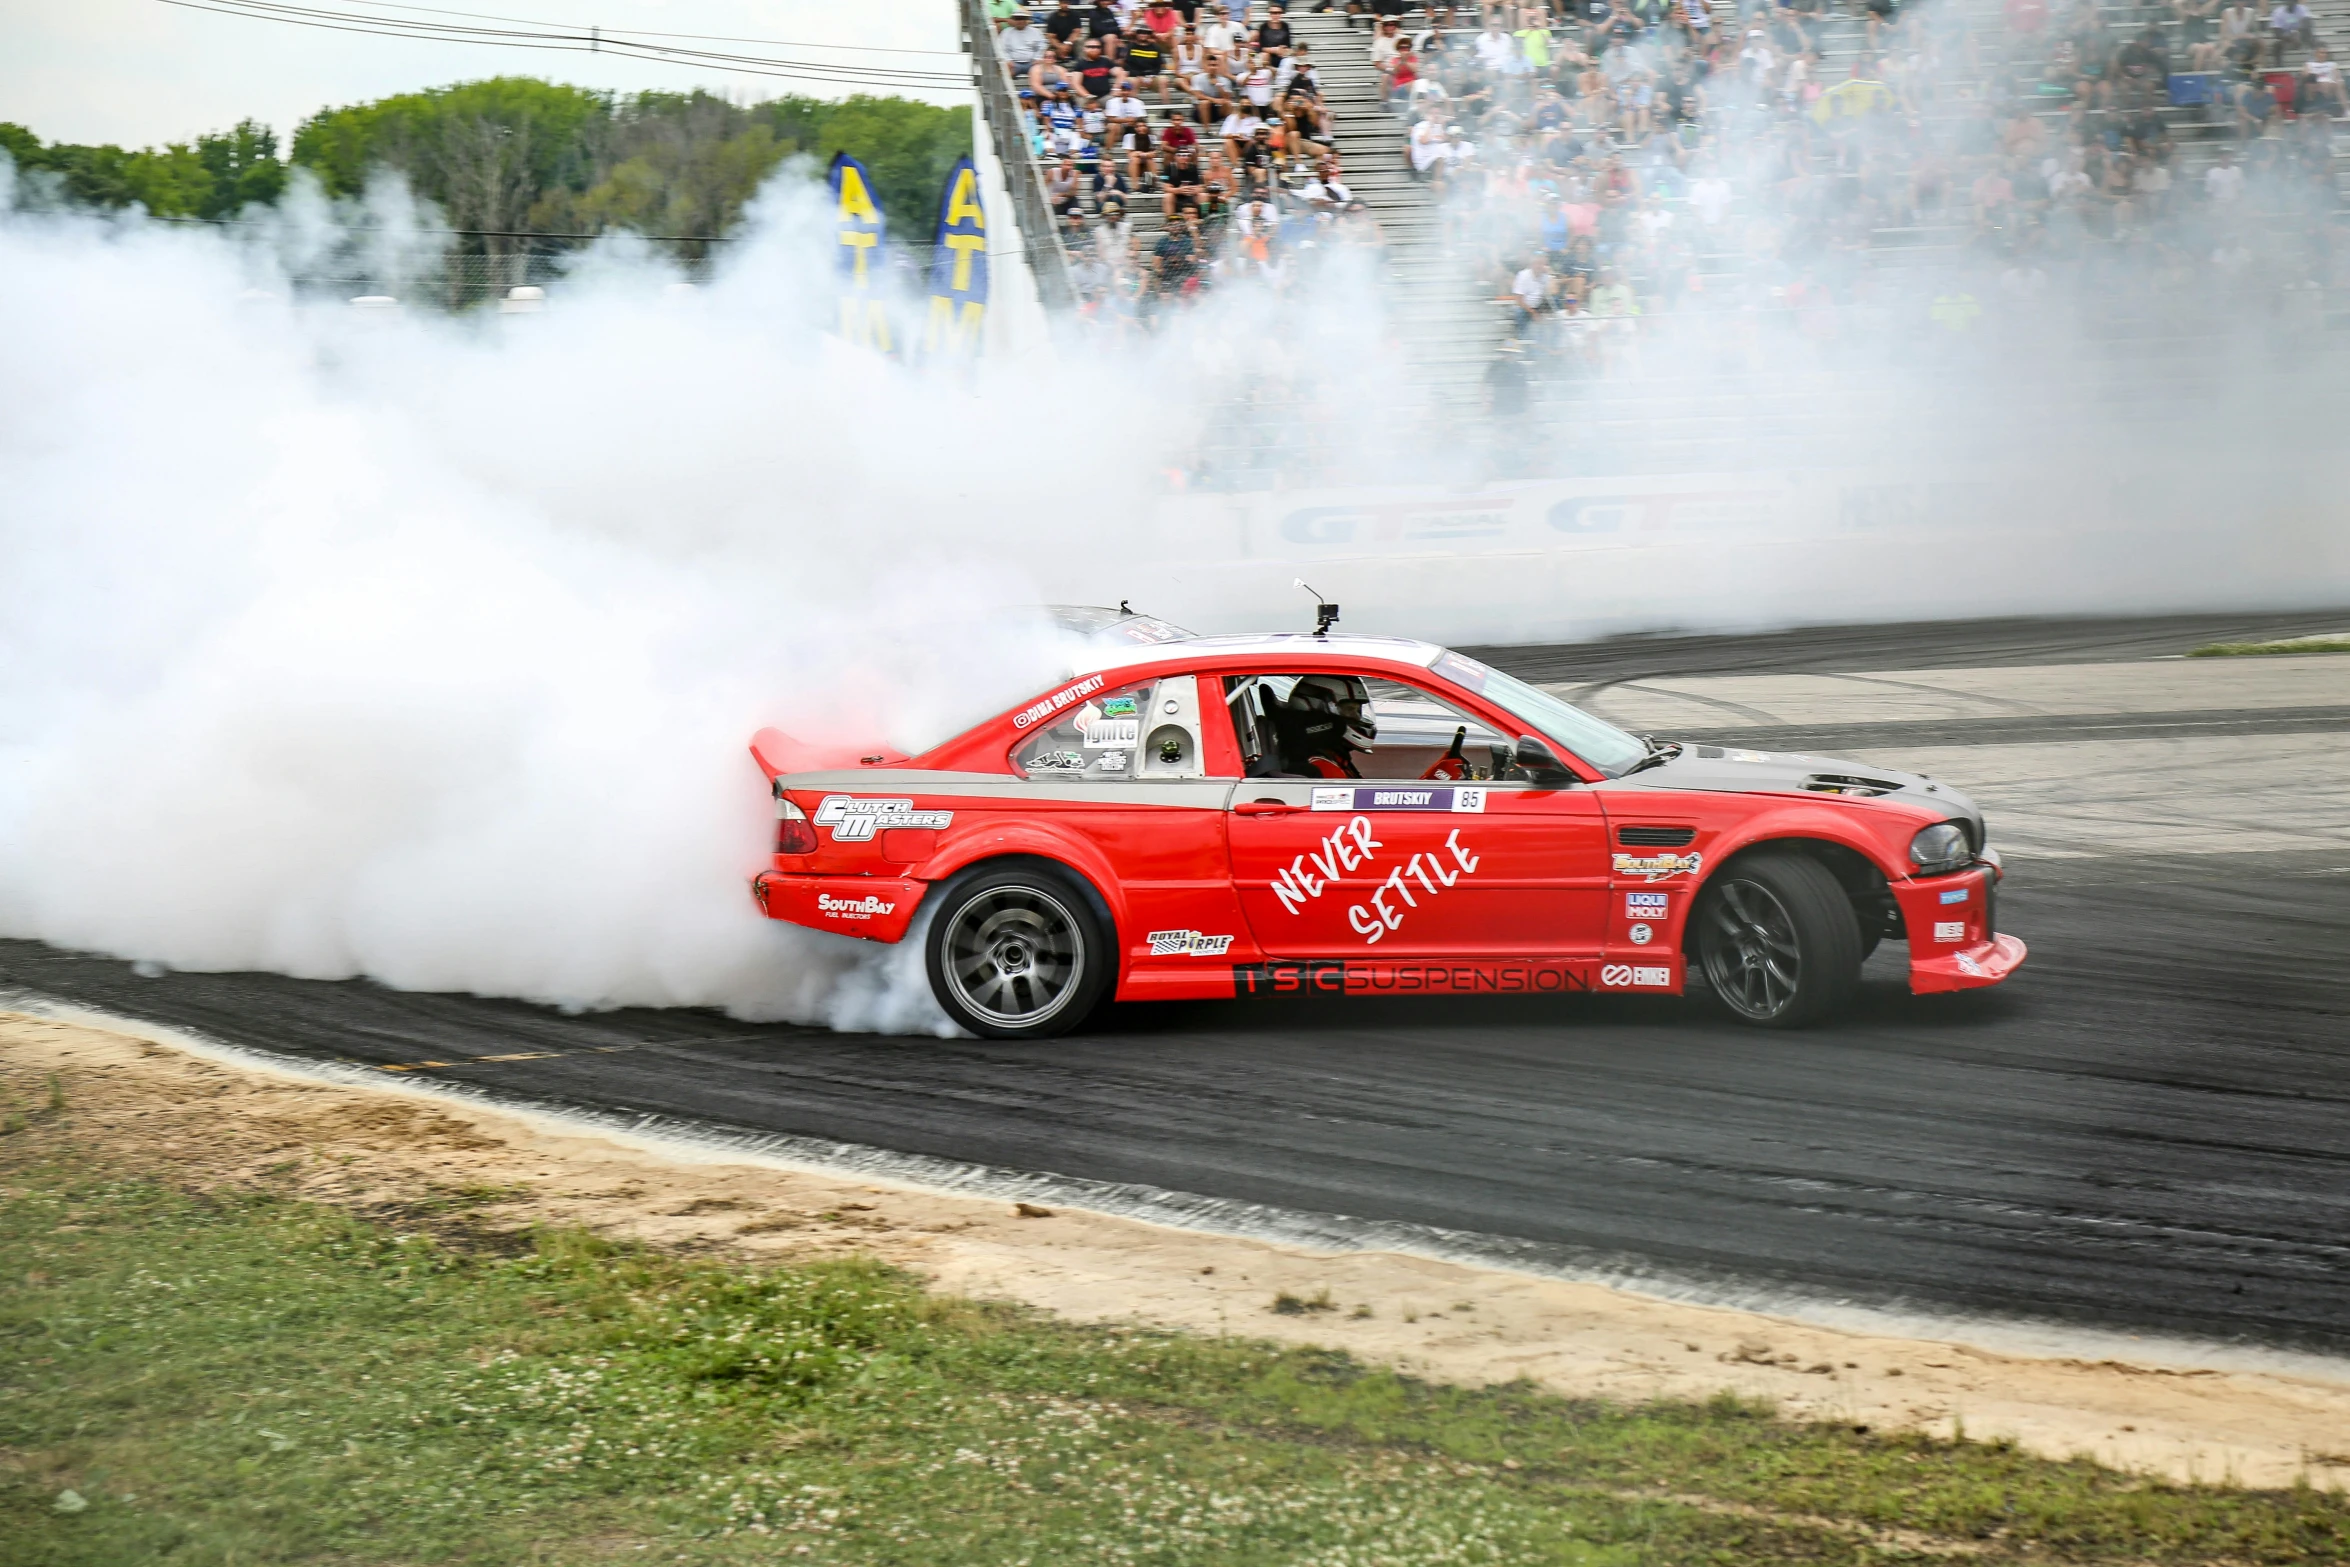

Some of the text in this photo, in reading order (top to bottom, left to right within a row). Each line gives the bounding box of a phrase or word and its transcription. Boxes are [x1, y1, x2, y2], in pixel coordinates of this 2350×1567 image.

[1028, 699, 1054, 722] DIMA
[1051, 674, 1105, 709] BRUTSKIY
[1086, 720, 1136, 744] ignite
[1373, 791, 1433, 806] BRUTSKIY
[1461, 791, 1480, 808] 85
[818, 799, 909, 821] CLUTCH
[837, 813, 948, 837] MASTERS
[1270, 815, 1383, 915] NEVER
[1348, 828, 1481, 945] SETTLE
[1628, 894, 1666, 906] LIQUI
[1629, 907, 1667, 918] MOLY
[1149, 931, 1187, 941] ROYAL
[1178, 936, 1228, 951] PURPLE
[1345, 967, 1589, 991] SUSPENSION
